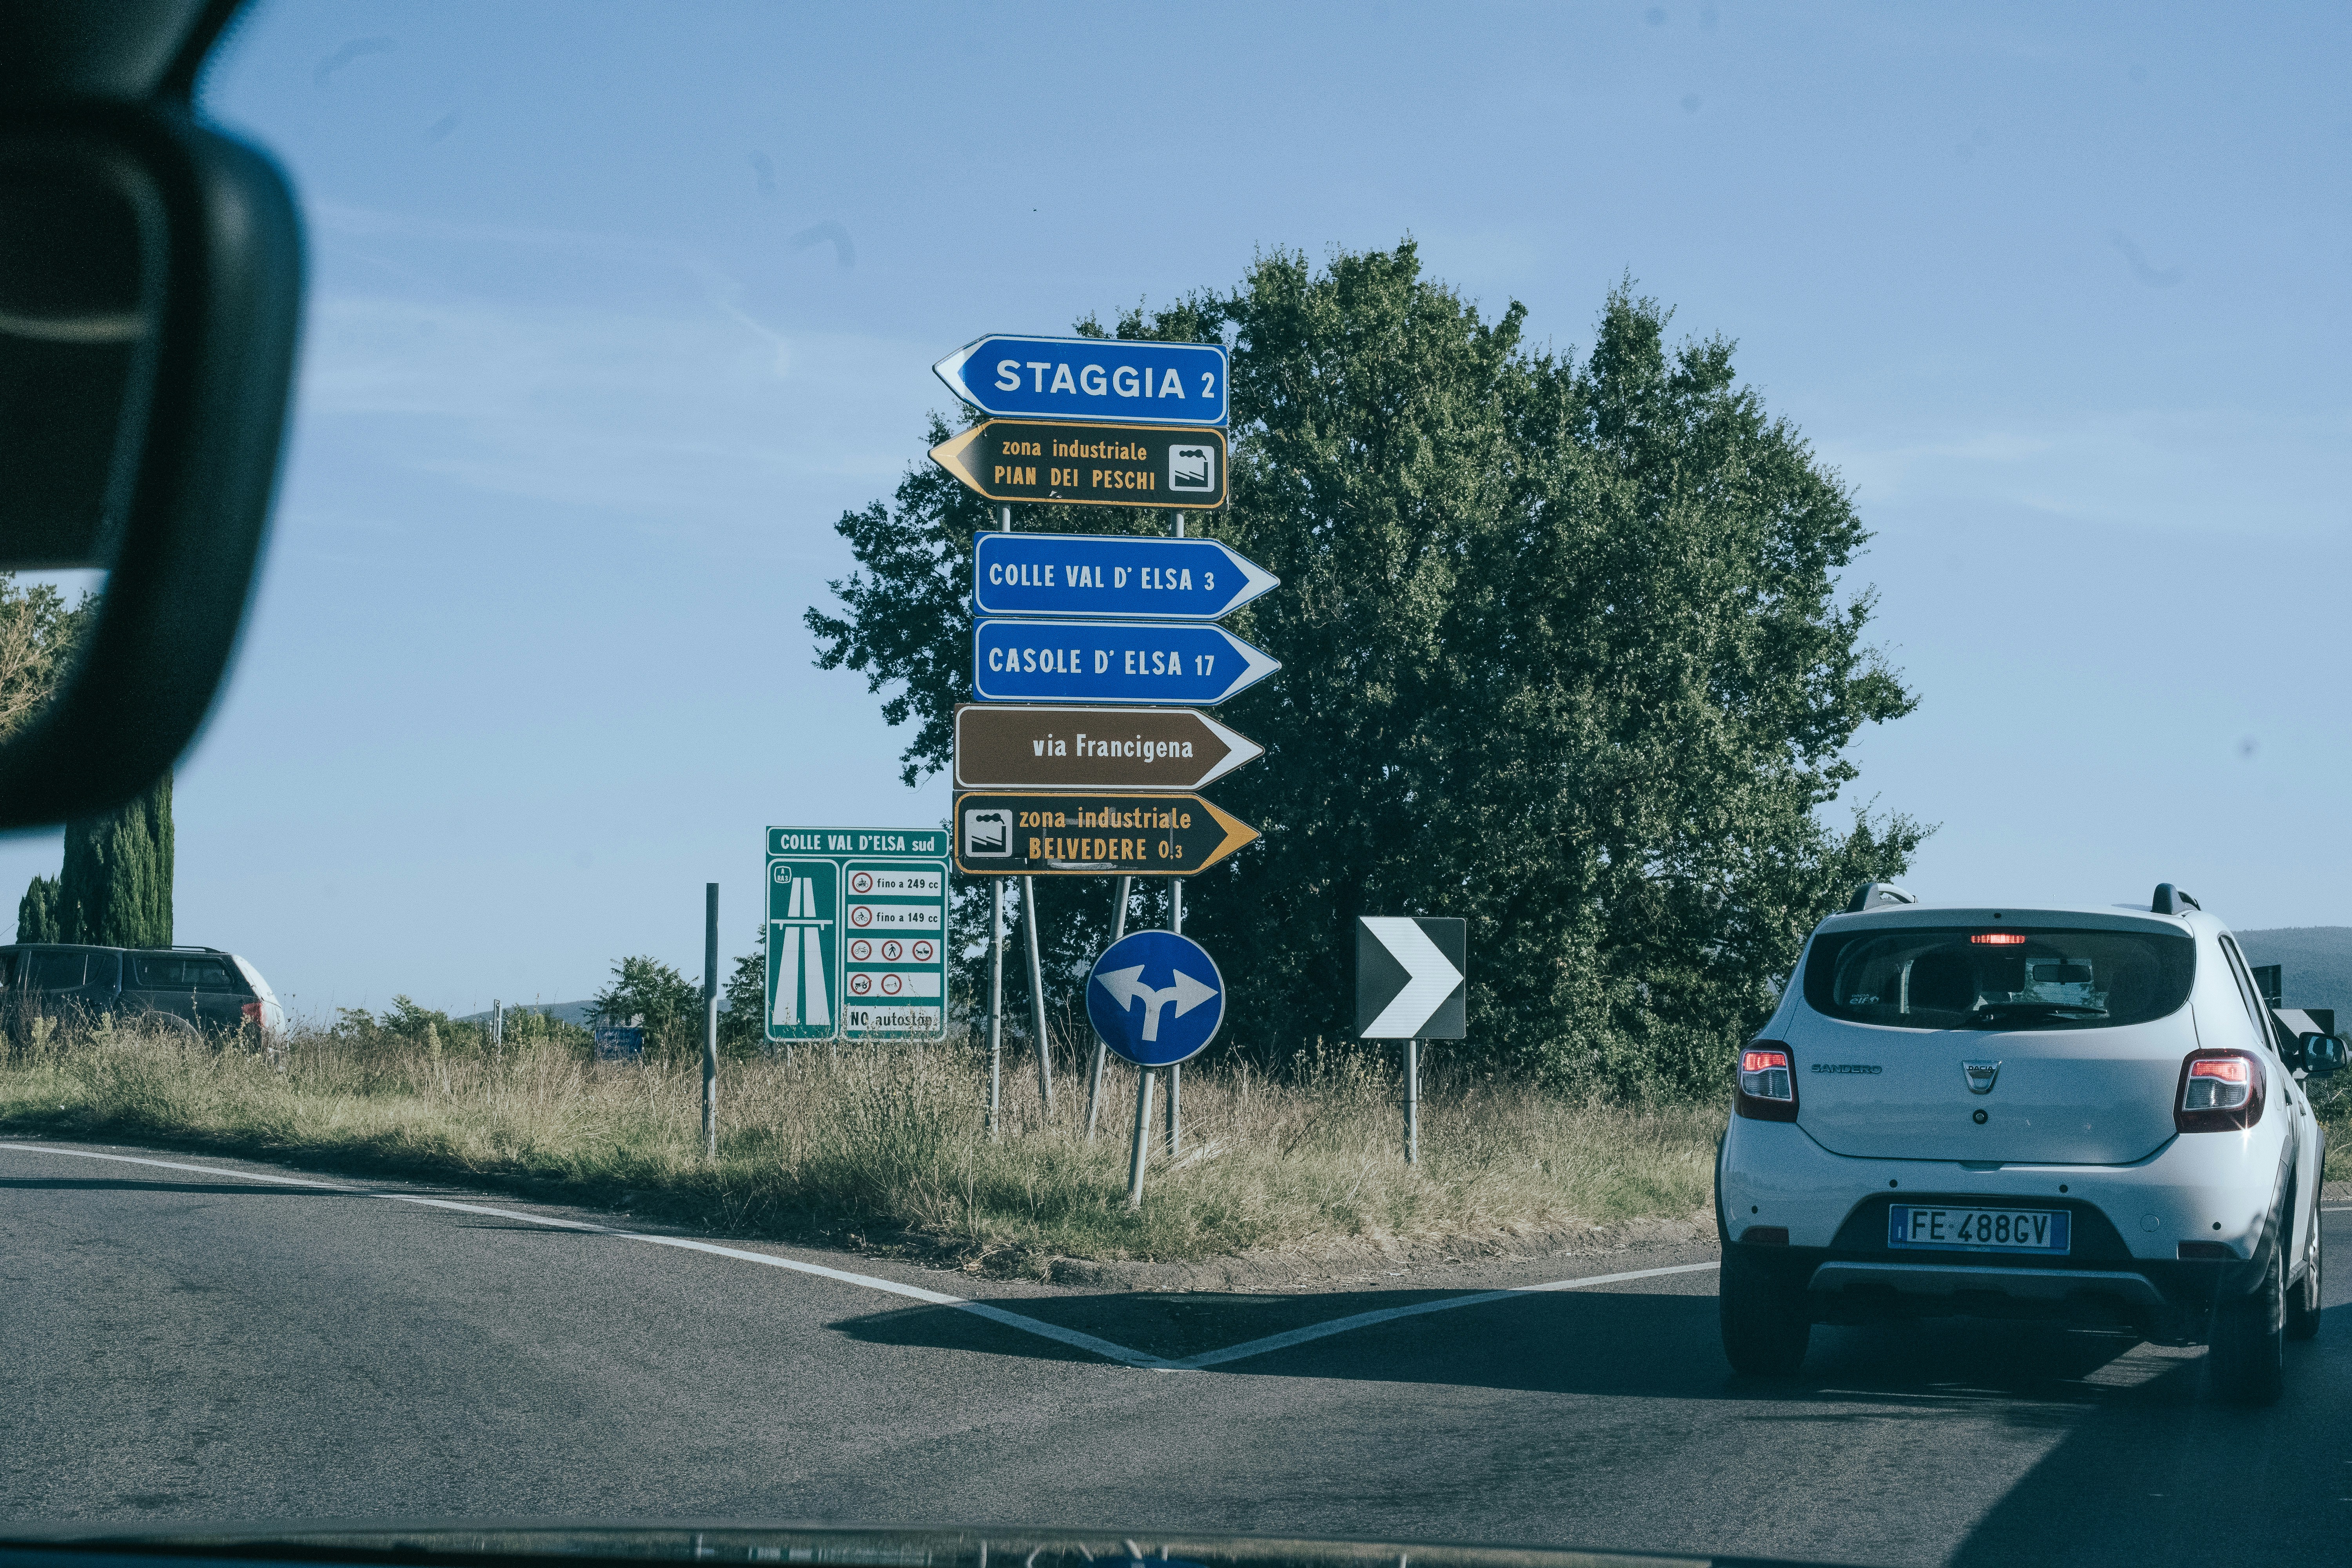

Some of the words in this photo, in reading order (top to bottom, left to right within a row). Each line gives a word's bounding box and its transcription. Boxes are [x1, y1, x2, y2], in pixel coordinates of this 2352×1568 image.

[995, 360, 1185, 399] STAGGIA
[1201, 372, 1214, 398] 2
[1002, 440, 1041, 456] zona
[1053, 439, 1147, 460] industriale
[995, 466, 1036, 485] PIAN
[1051, 468, 1078, 487] DEI
[1093, 470, 1155, 490] PESCHI
[989, 563, 1054, 587] COLLE
[1066, 566, 1104, 588] VAL
[1114, 567, 1132, 588] D'
[1142, 568, 1192, 590] ELSA
[1204, 572, 1214, 590] 3
[989, 648, 1081, 673] CASOLE
[1095, 650, 1114, 674] D'
[1125, 651, 1182, 675] ELSA
[1195, 655, 1214, 676] 17
[1033, 733, 1067, 756] via
[1077, 734, 1193, 763] Francigena
[1020, 809, 1066, 828] zona
[1078, 807, 1191, 829] industriale
[781, 835, 821, 850] COLLE
[828, 835, 853, 850] VAL
[859, 836, 905, 851] D'ELSA
[912, 837, 934, 851] sud
[1029, 838, 1147, 860] BELVEDERE
[1159, 841, 1182, 860] 0,3
[877, 878, 895, 888] fino
[907, 879, 925, 888] 249
[877, 913, 895, 922] fino
[908, 913, 924, 922] 149
[851, 1012, 869, 1026] NO
[1811, 1064, 1882, 1074] SANDERO
[1912, 1211, 1946, 1240] FE
[1958, 1214, 2047, 1244] 488GV
